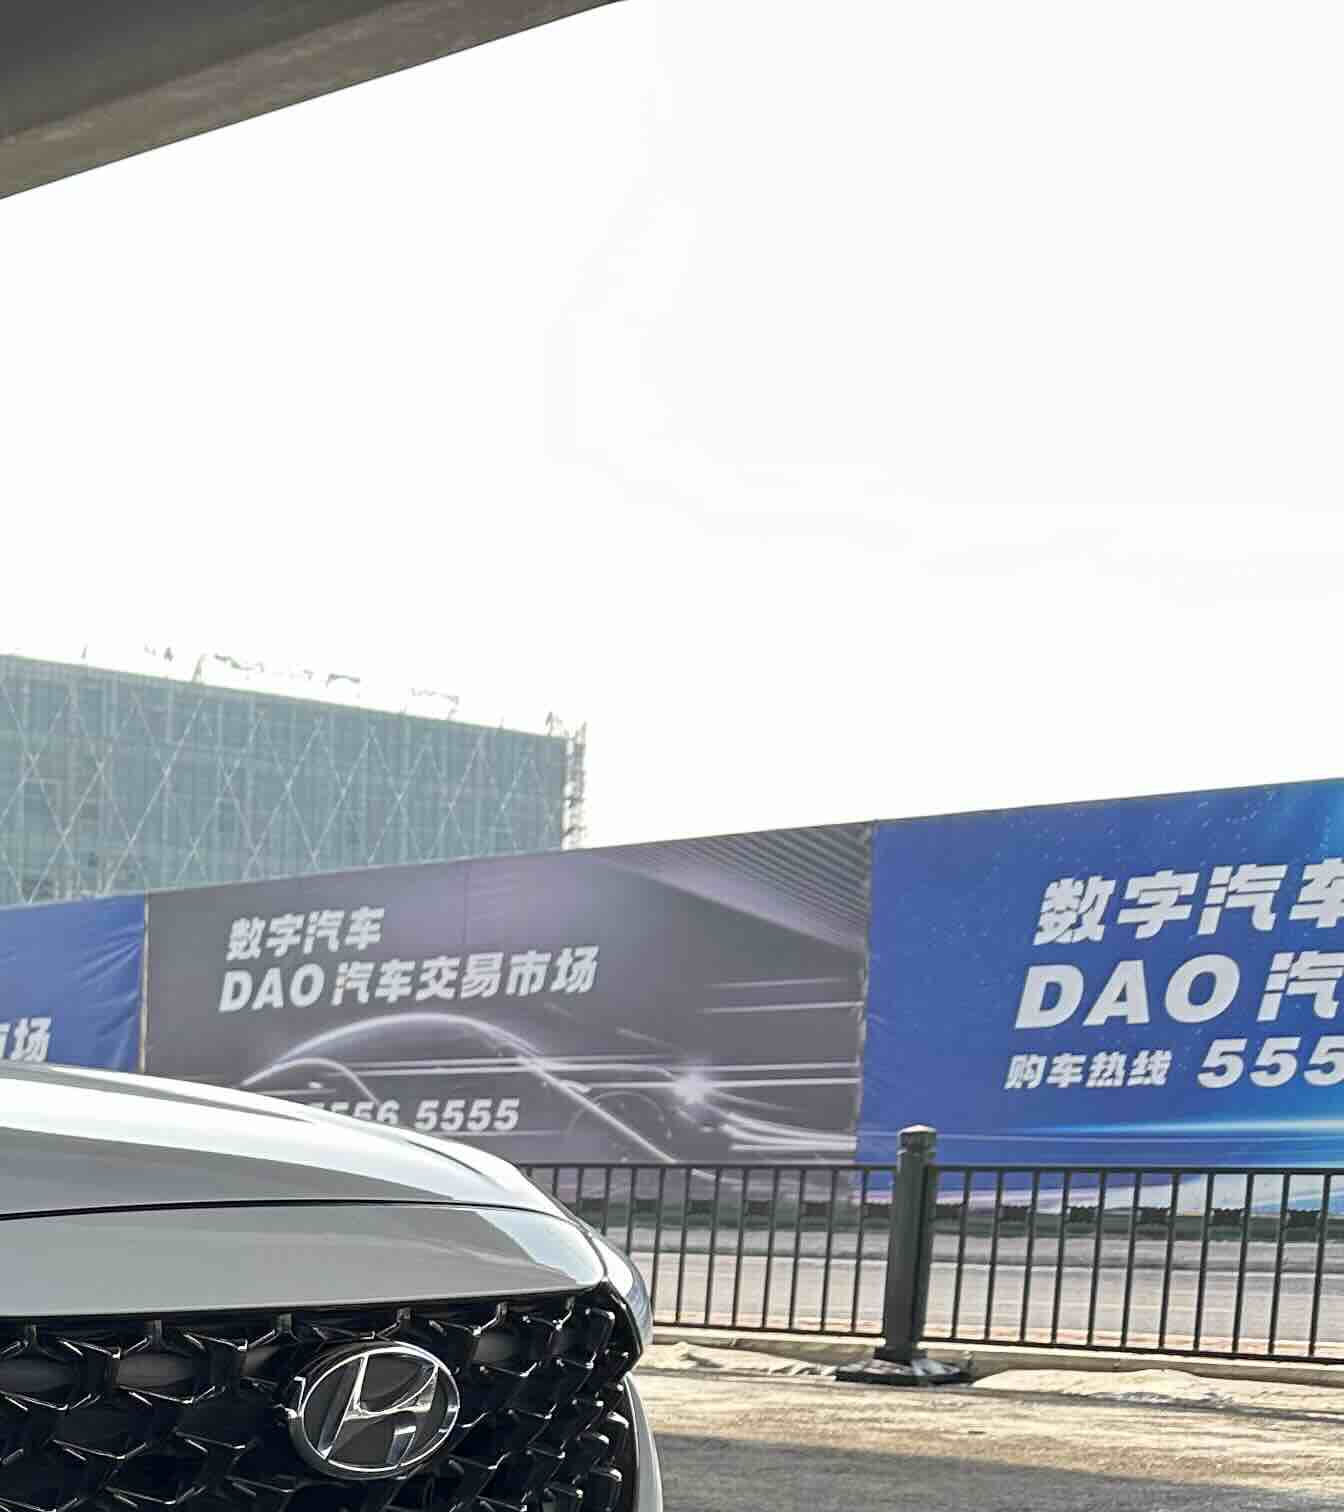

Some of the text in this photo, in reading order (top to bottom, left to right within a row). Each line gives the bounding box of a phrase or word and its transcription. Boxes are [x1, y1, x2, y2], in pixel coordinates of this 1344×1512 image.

[1032, 857, 1344, 946] 数字汽车
[226, 906, 385, 961] 数字汽车
[218, 945, 600, 1012] DAO 汽车交易市场
[1015, 954, 1240, 1030] DAO
[1004, 1036, 1344, 1089] 购车热线 555
[414, 1097, 521, 1132] 5555
